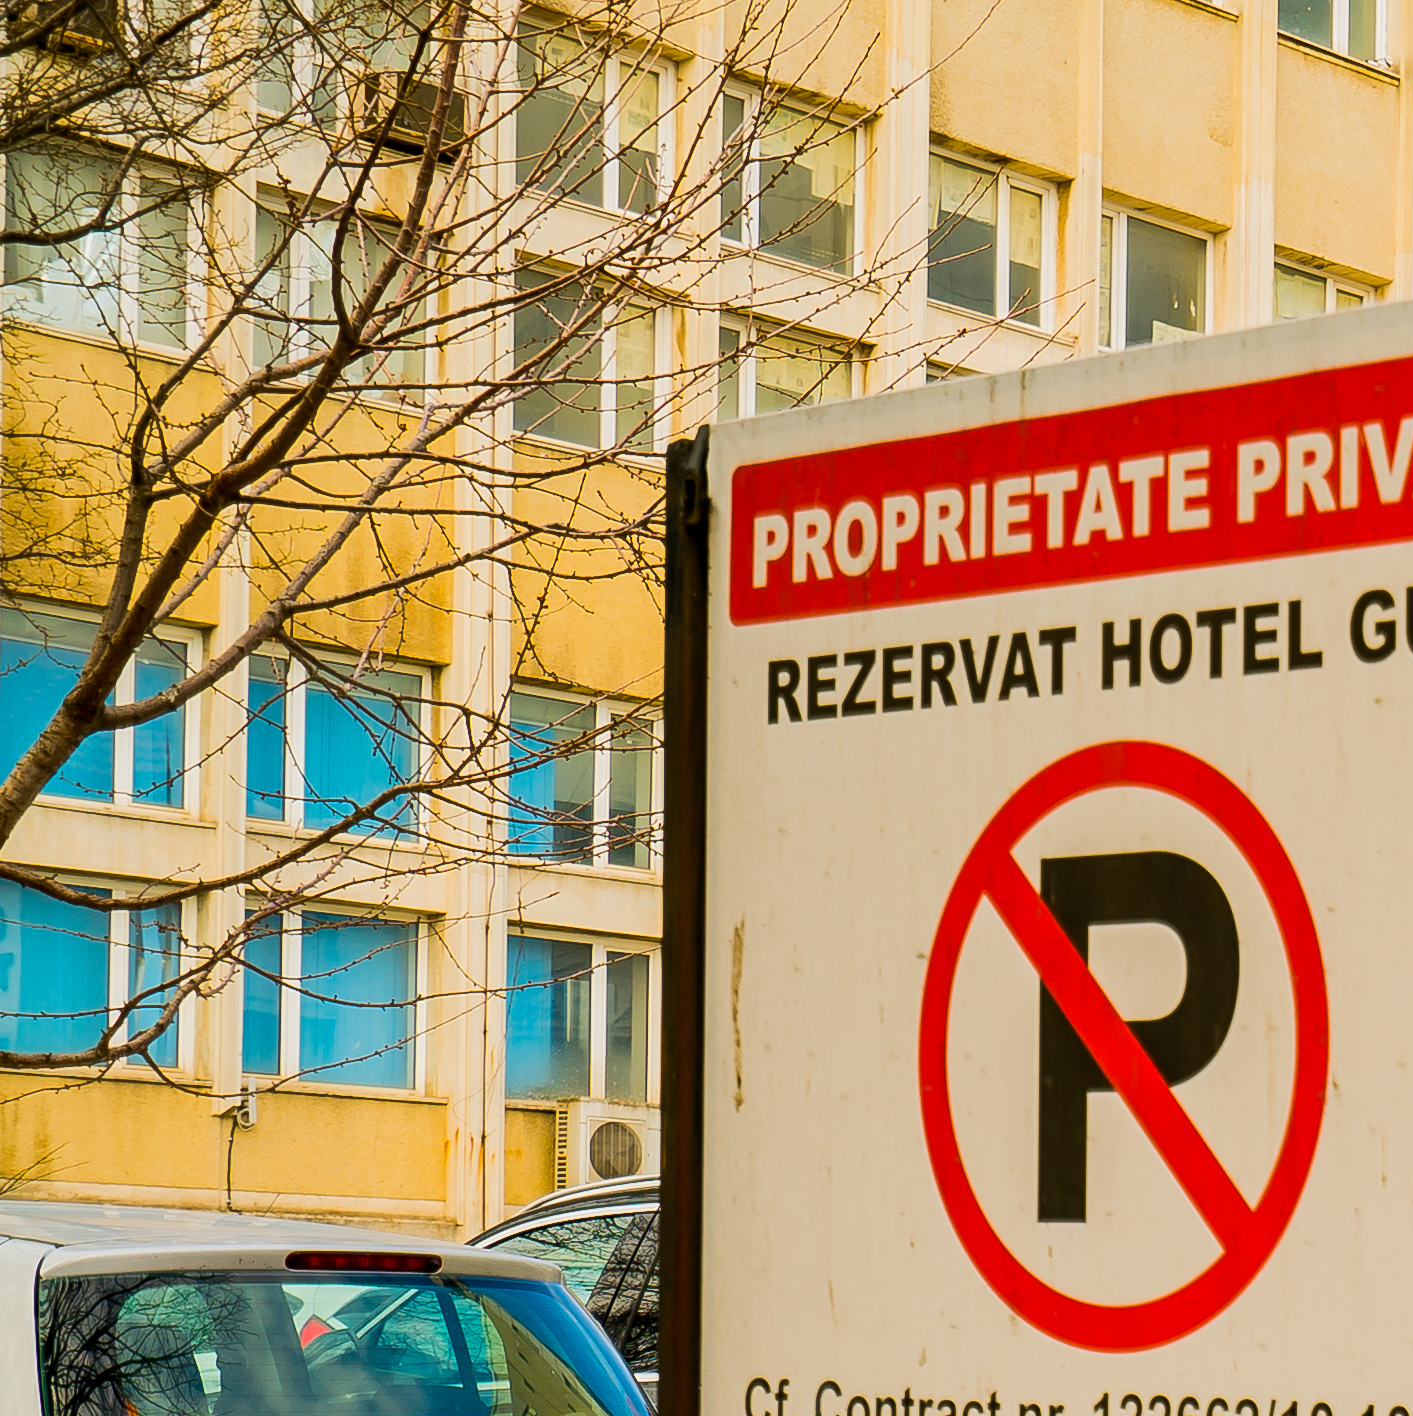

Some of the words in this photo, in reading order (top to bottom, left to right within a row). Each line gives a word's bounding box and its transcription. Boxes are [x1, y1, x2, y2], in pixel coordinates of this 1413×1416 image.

[752, 448, 1211, 589] PROPRIETATE
[766, 625, 1078, 726] REZERVAT
[1100, 598, 1324, 691] HOTEL
